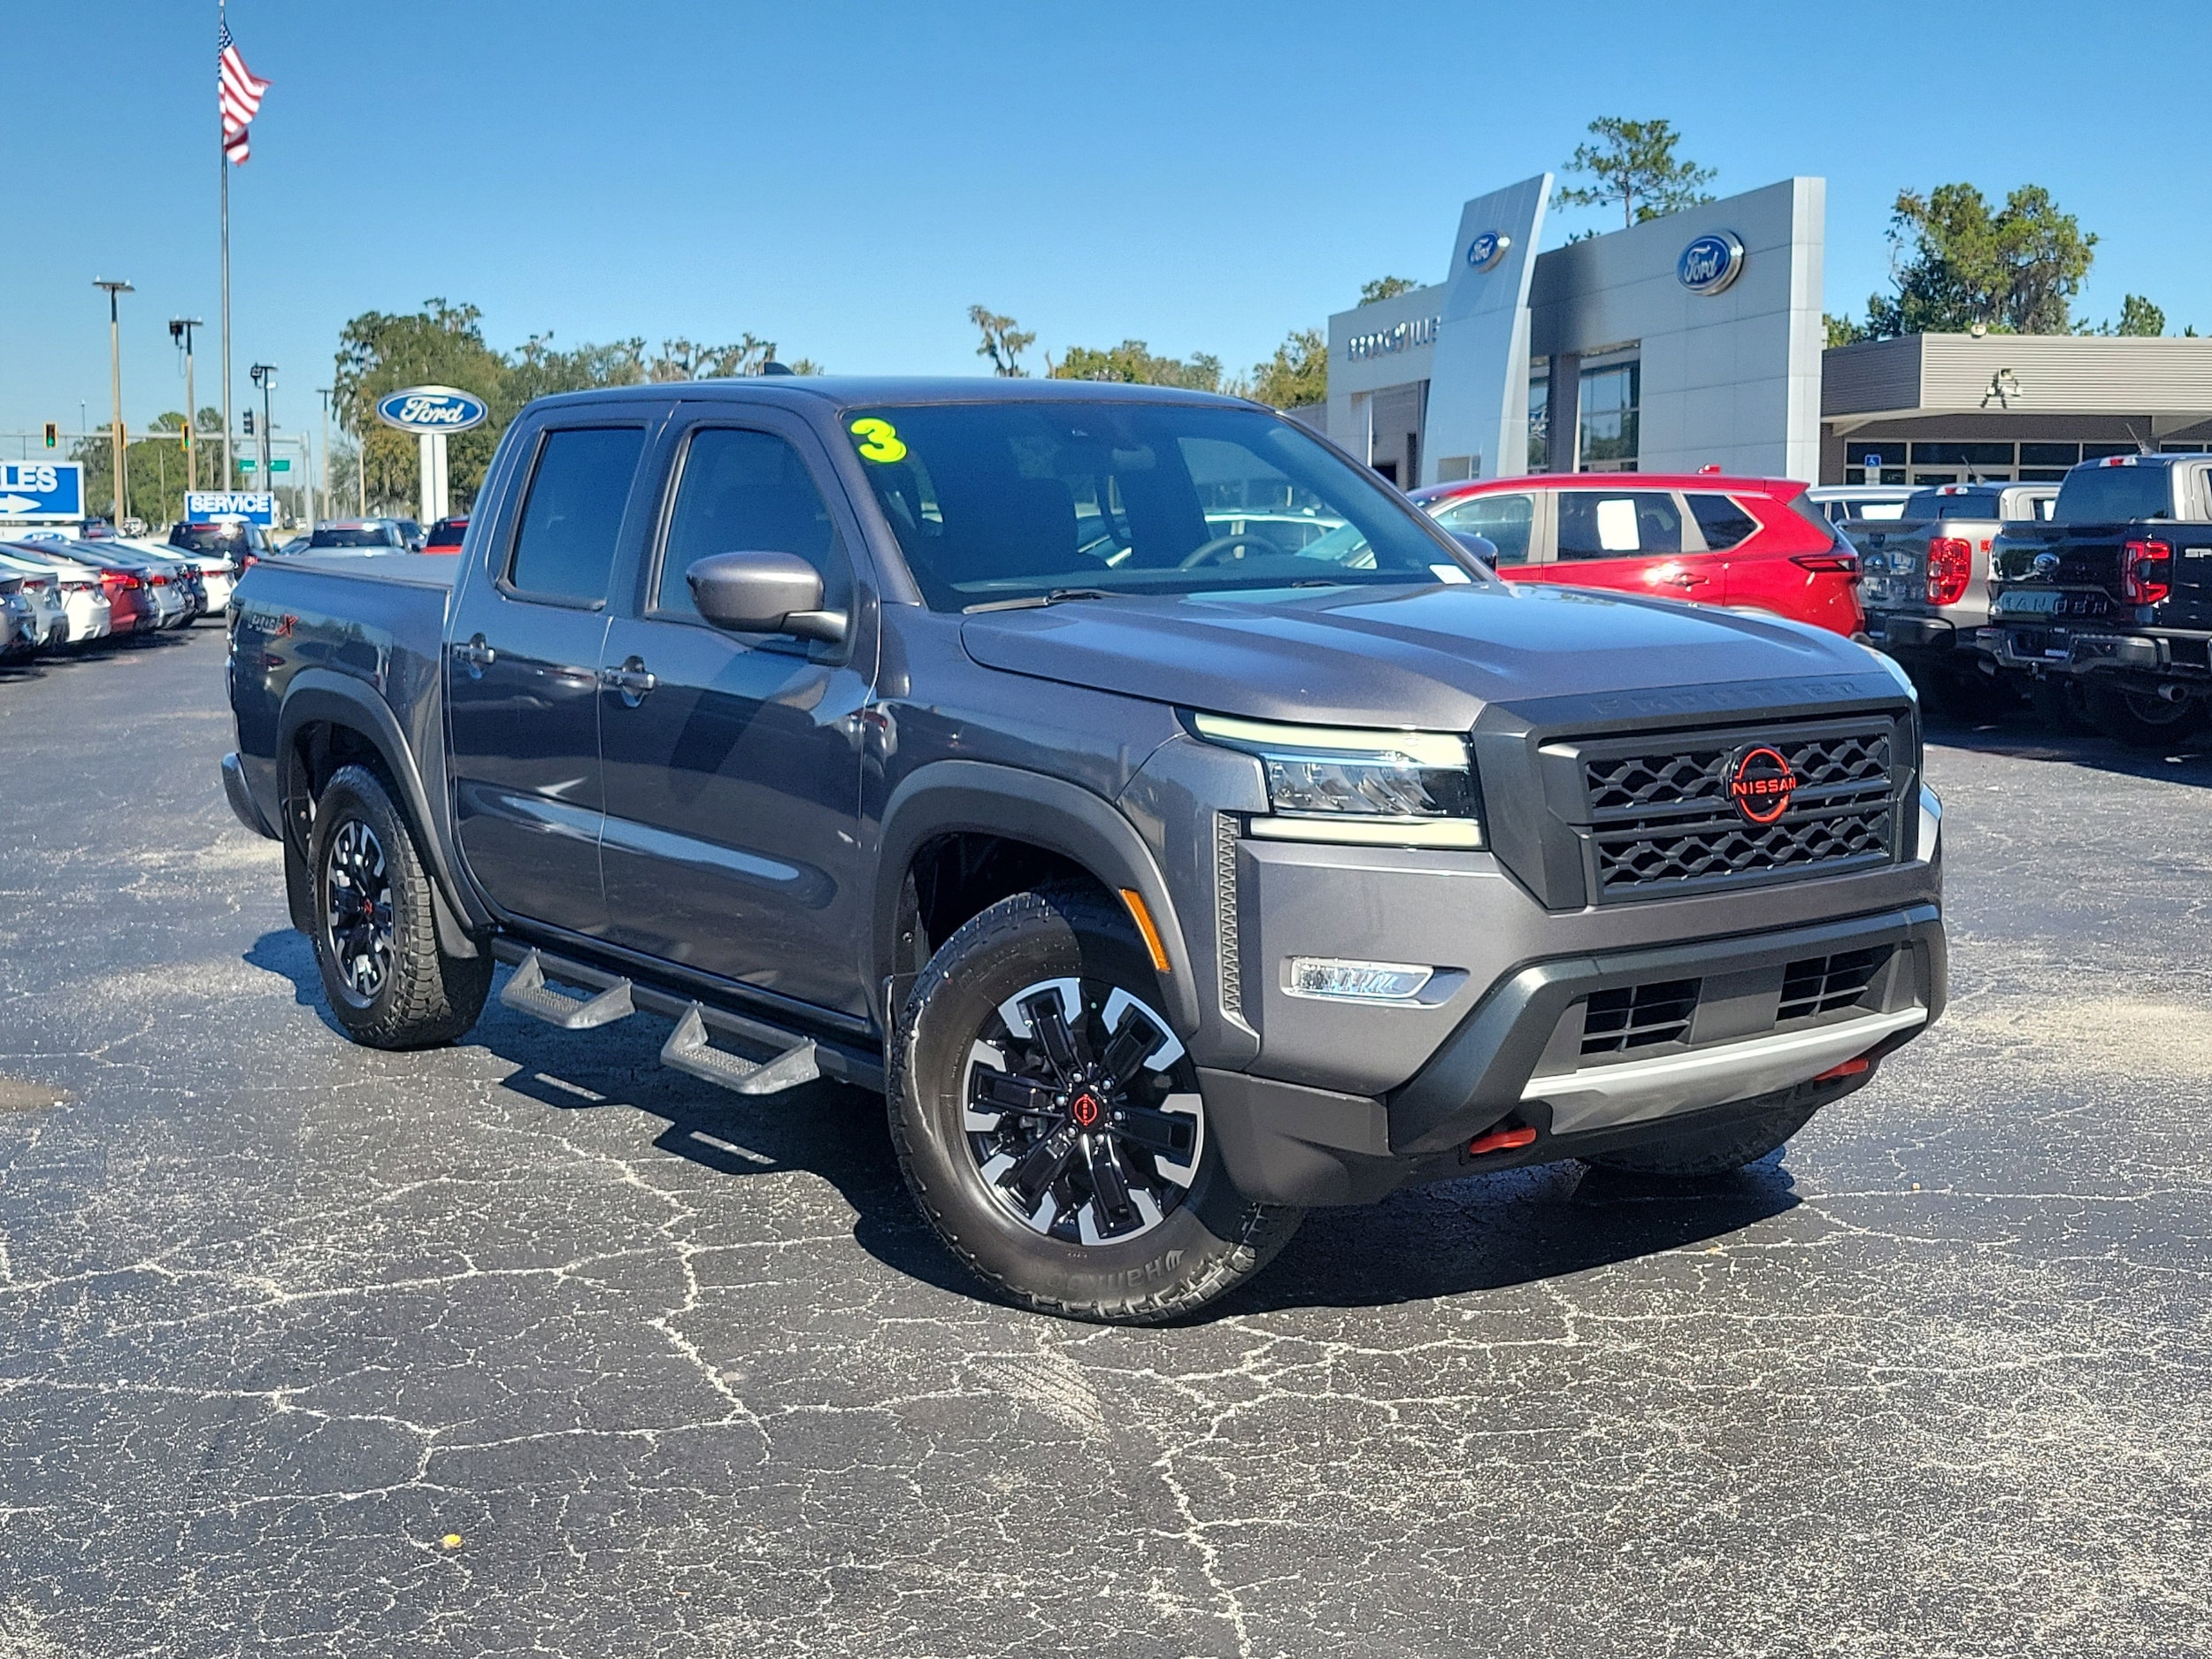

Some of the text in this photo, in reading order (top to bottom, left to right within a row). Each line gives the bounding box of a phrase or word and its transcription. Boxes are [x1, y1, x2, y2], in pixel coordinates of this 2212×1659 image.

[1684, 244, 1719, 283] Ford
[399, 396, 465, 423] Ford
[850, 418, 907, 463] 3
[0, 466, 58, 493] LES
[190, 495, 270, 513] SERVICE
[1732, 777, 1796, 795] NISSAN
